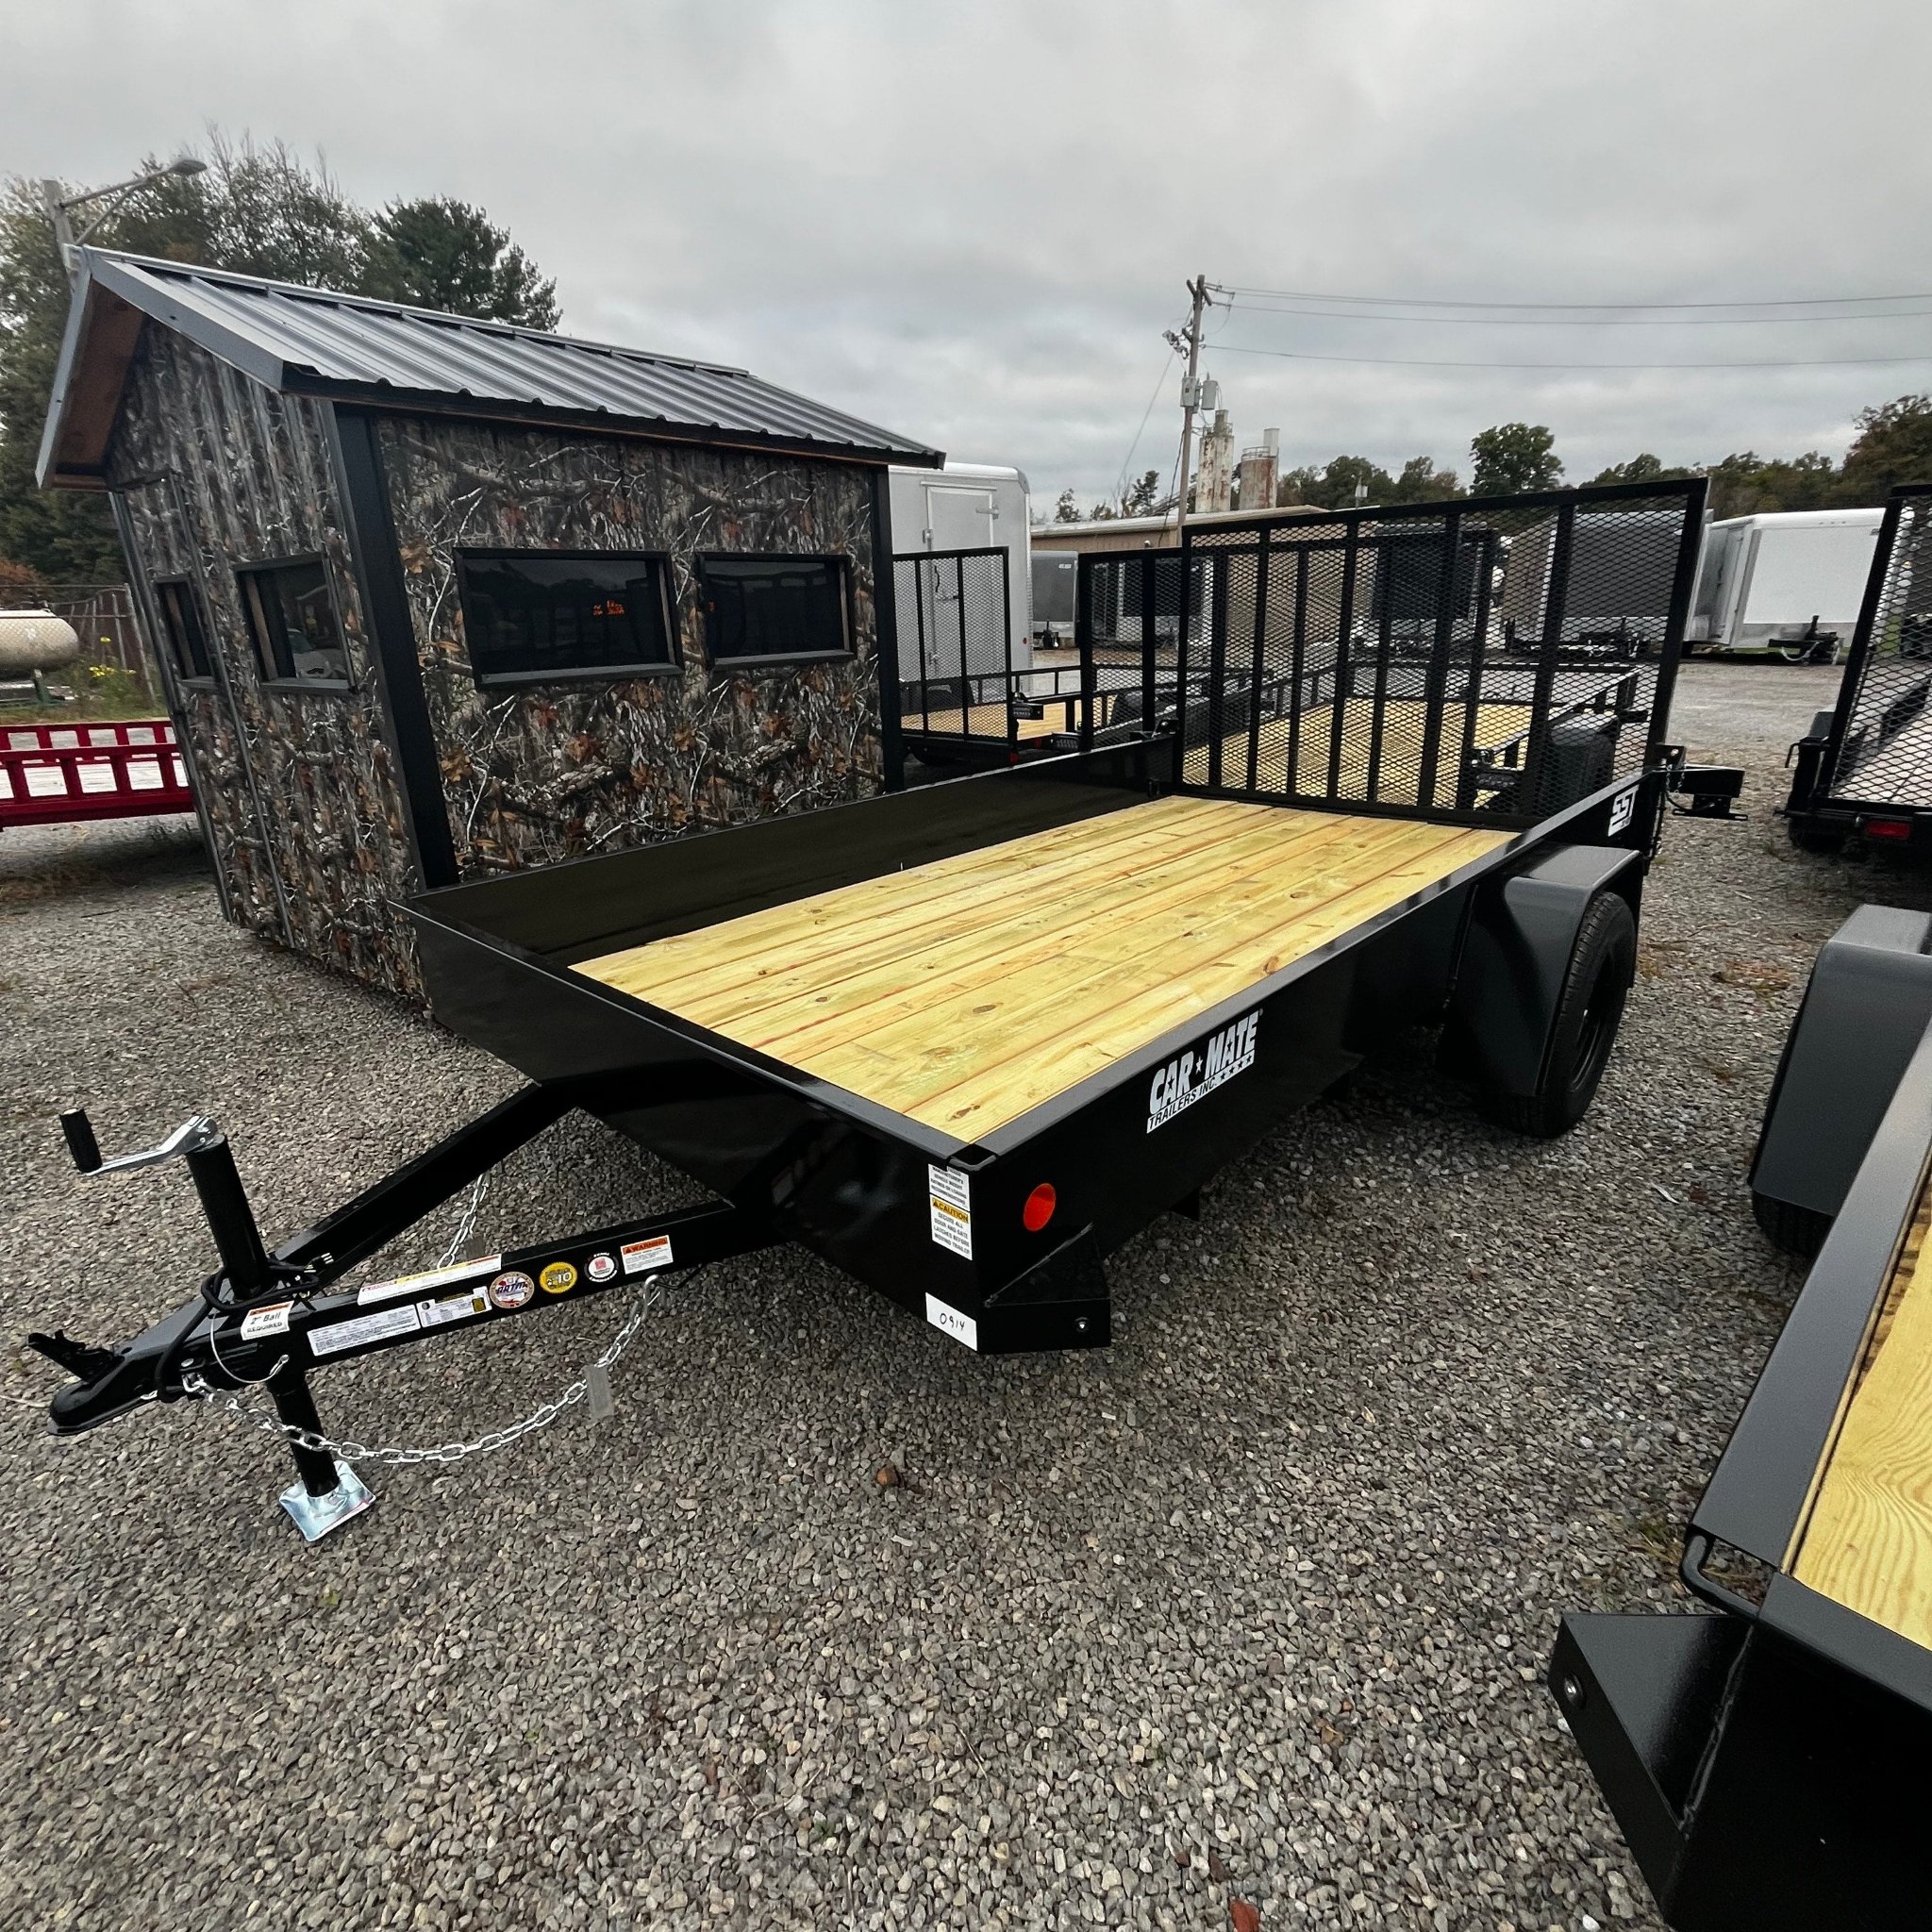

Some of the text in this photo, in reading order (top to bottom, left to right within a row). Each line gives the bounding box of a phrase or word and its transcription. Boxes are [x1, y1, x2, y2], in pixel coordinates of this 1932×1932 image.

[1150, 1010, 1259, 1114] CAR MATE
[1149, 1076, 1217, 1129] TRAILERS INC.
[938, 1211, 954, 1224] SECURE
[939, 1202, 969, 1223] CAUTION
[947, 1224, 957, 1233] AND
[957, 1228, 968, 1239] GATE
[934, 1232, 970, 1255] MOVING TRAILER
[953, 1235, 969, 1247] BEFORE
[263, 1312, 281, 1323] Ball
[940, 1312, 965, 1331] 0914
[247, 1322, 282, 1333] REQUIRED
